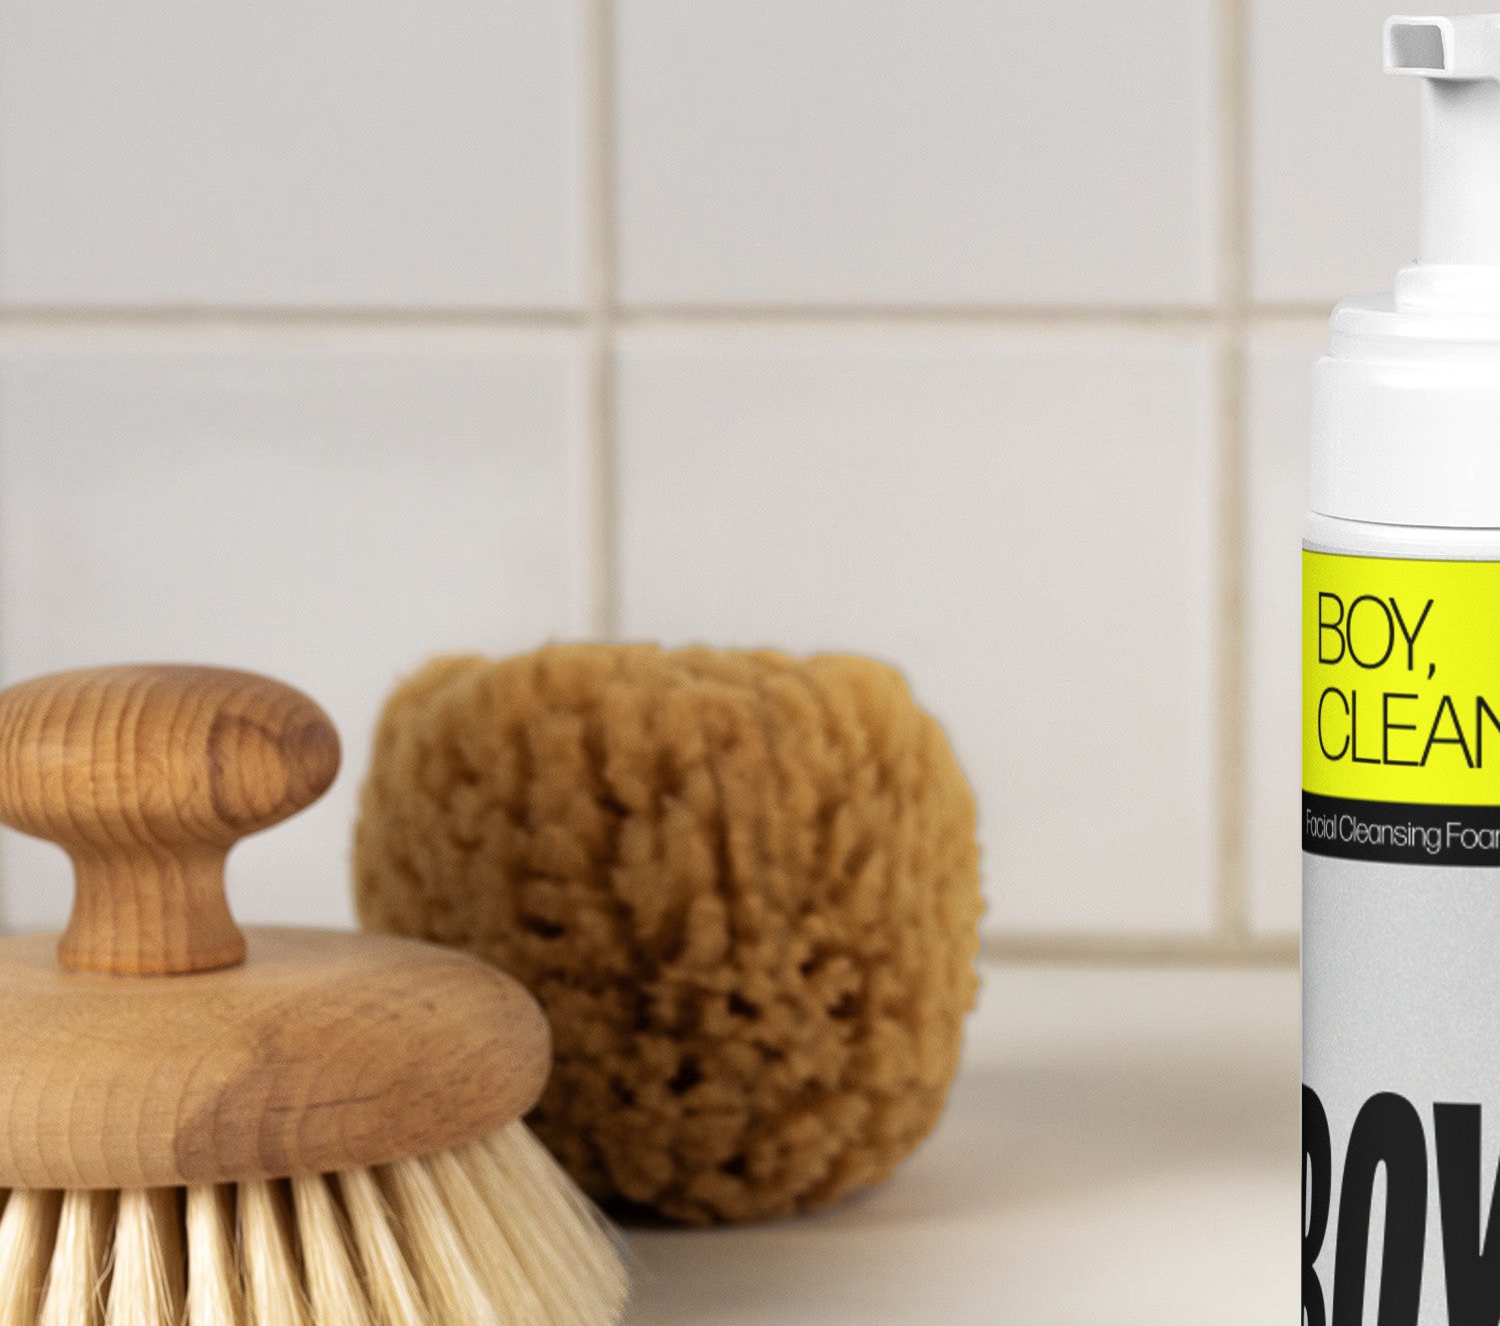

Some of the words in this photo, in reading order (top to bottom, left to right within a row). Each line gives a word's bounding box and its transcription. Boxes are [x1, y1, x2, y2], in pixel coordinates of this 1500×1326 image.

[1317, 591, 1436, 680] BOY,
[1306, 808, 1337, 841] Facial
[1339, 813, 1442, 855] Cleansing
